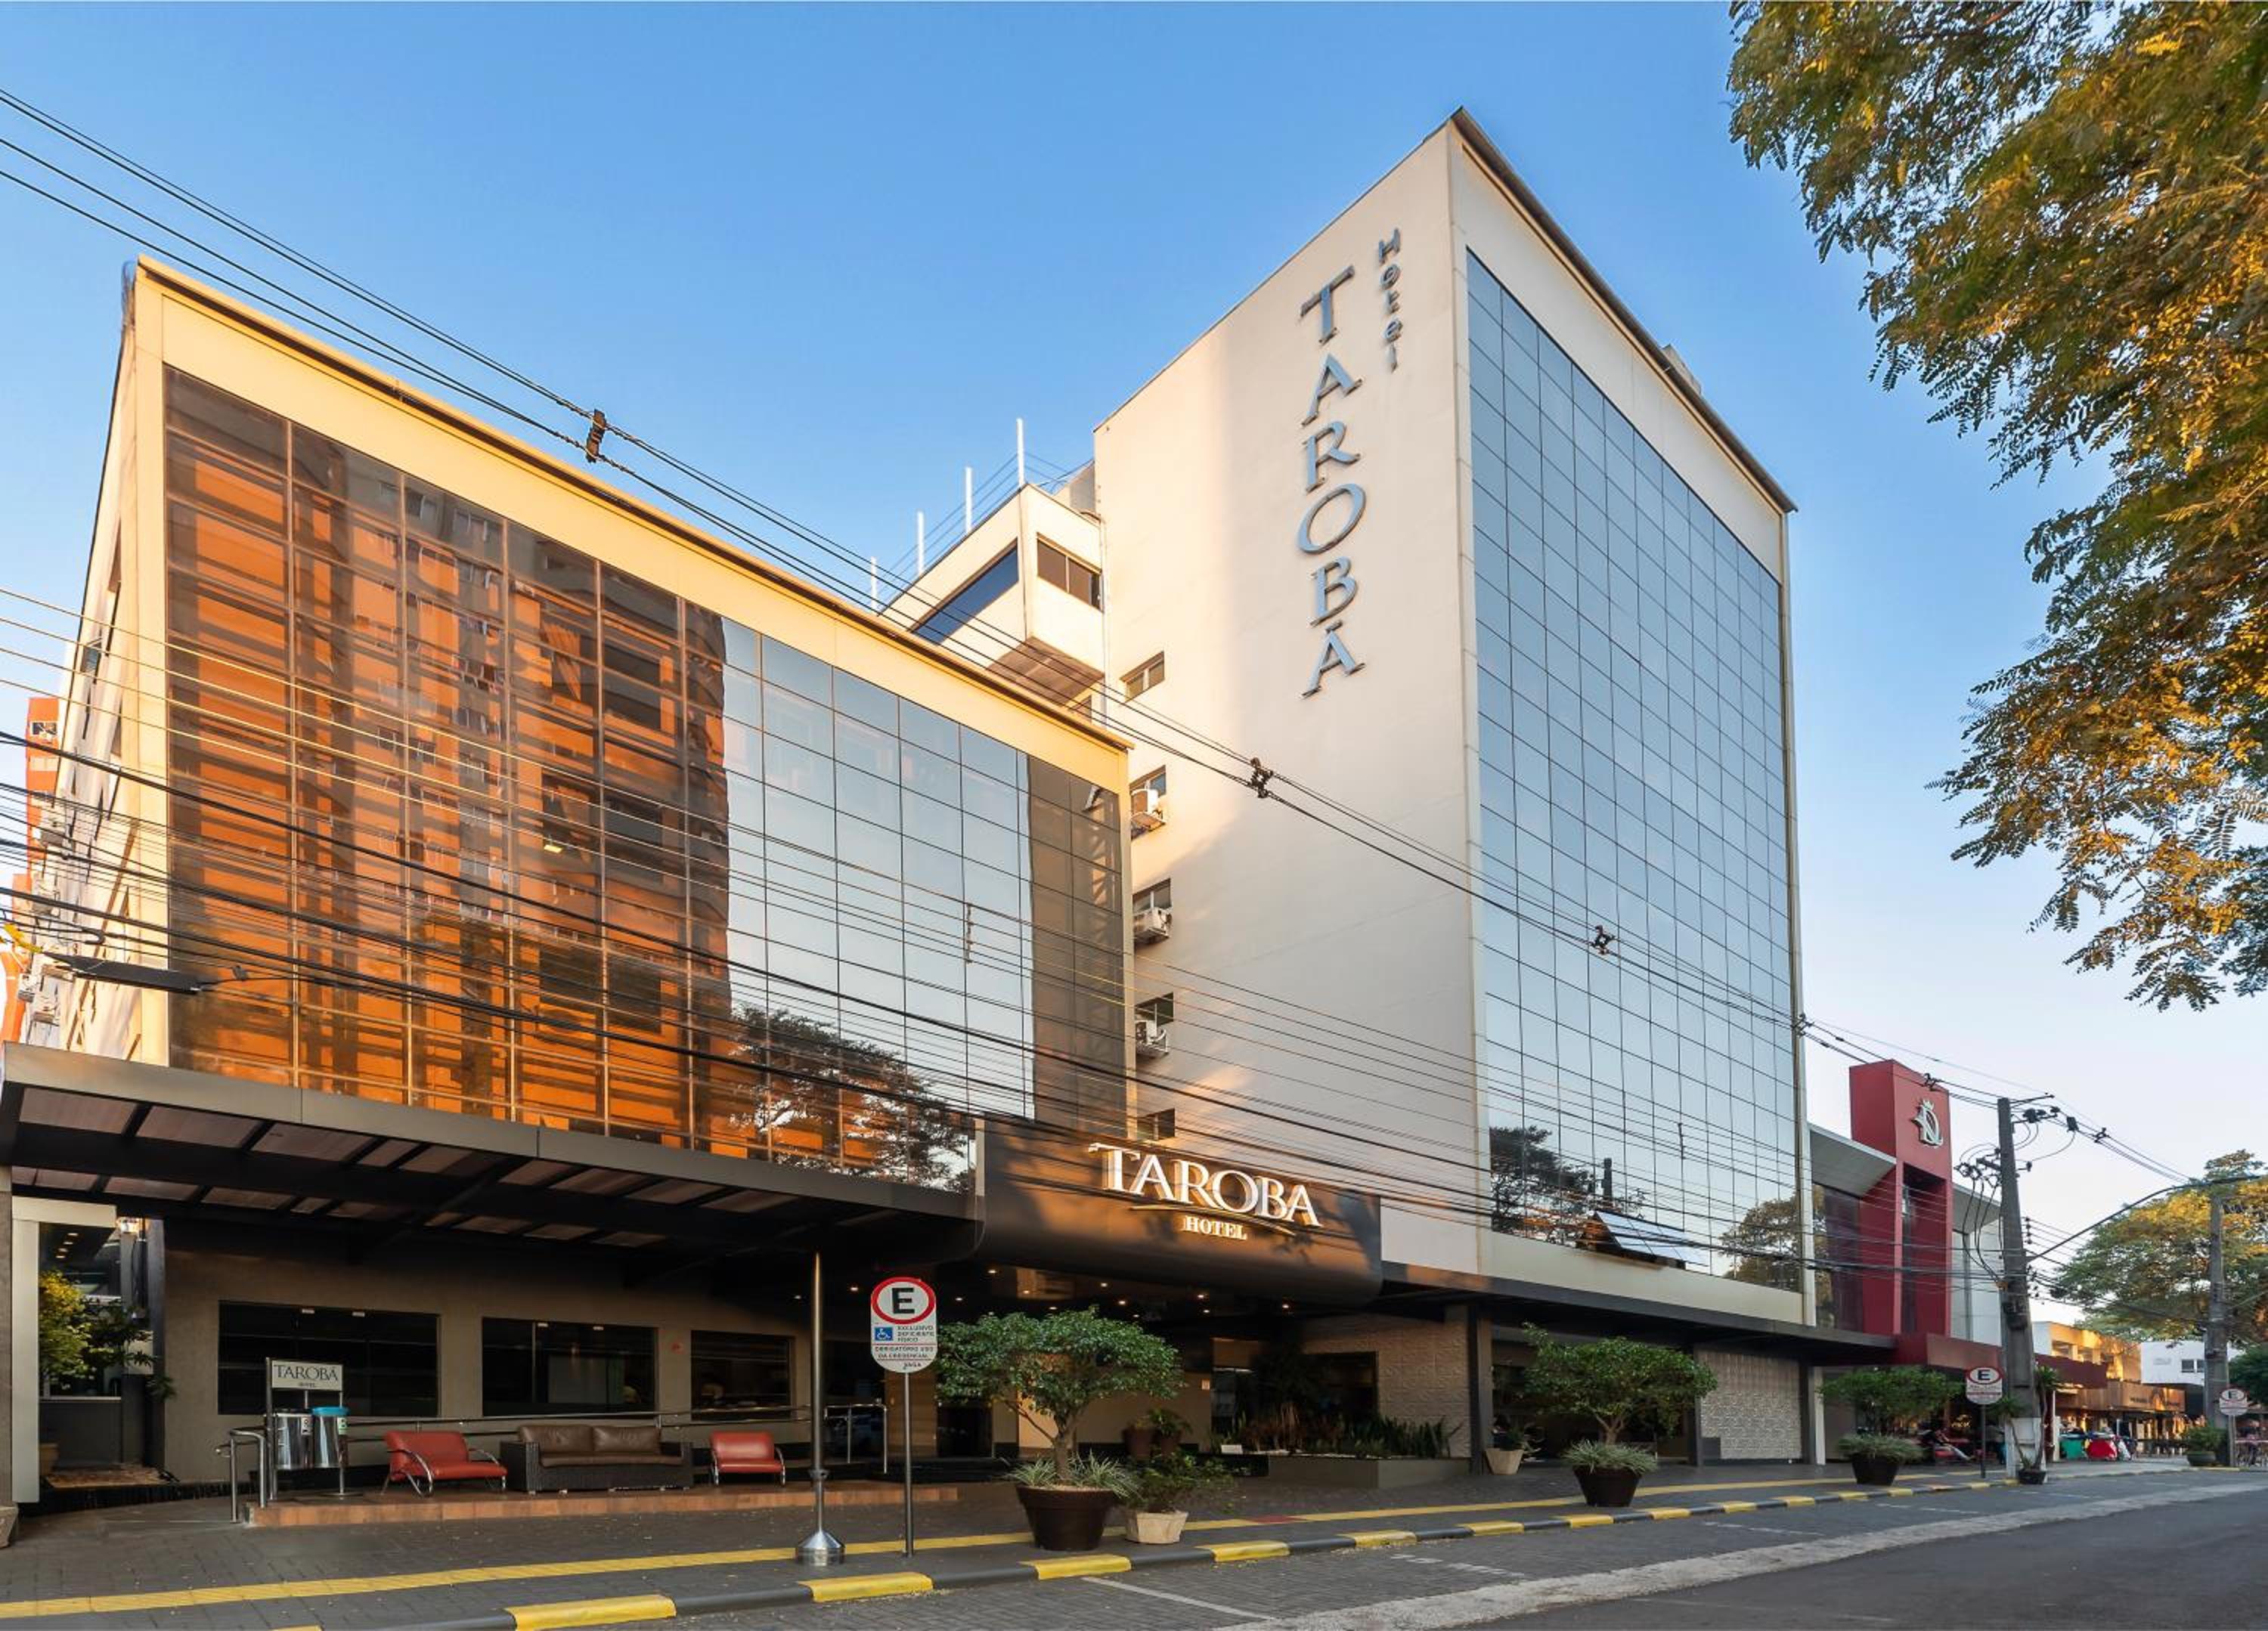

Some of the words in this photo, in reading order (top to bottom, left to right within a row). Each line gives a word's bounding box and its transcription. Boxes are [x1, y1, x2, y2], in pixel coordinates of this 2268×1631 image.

[1297, 265, 1367, 700] TAROBÁ
[1182, 1215, 1247, 1240] HOTEL
[891, 1287, 916, 1314] E
[1977, 1369, 1991, 1382] E
